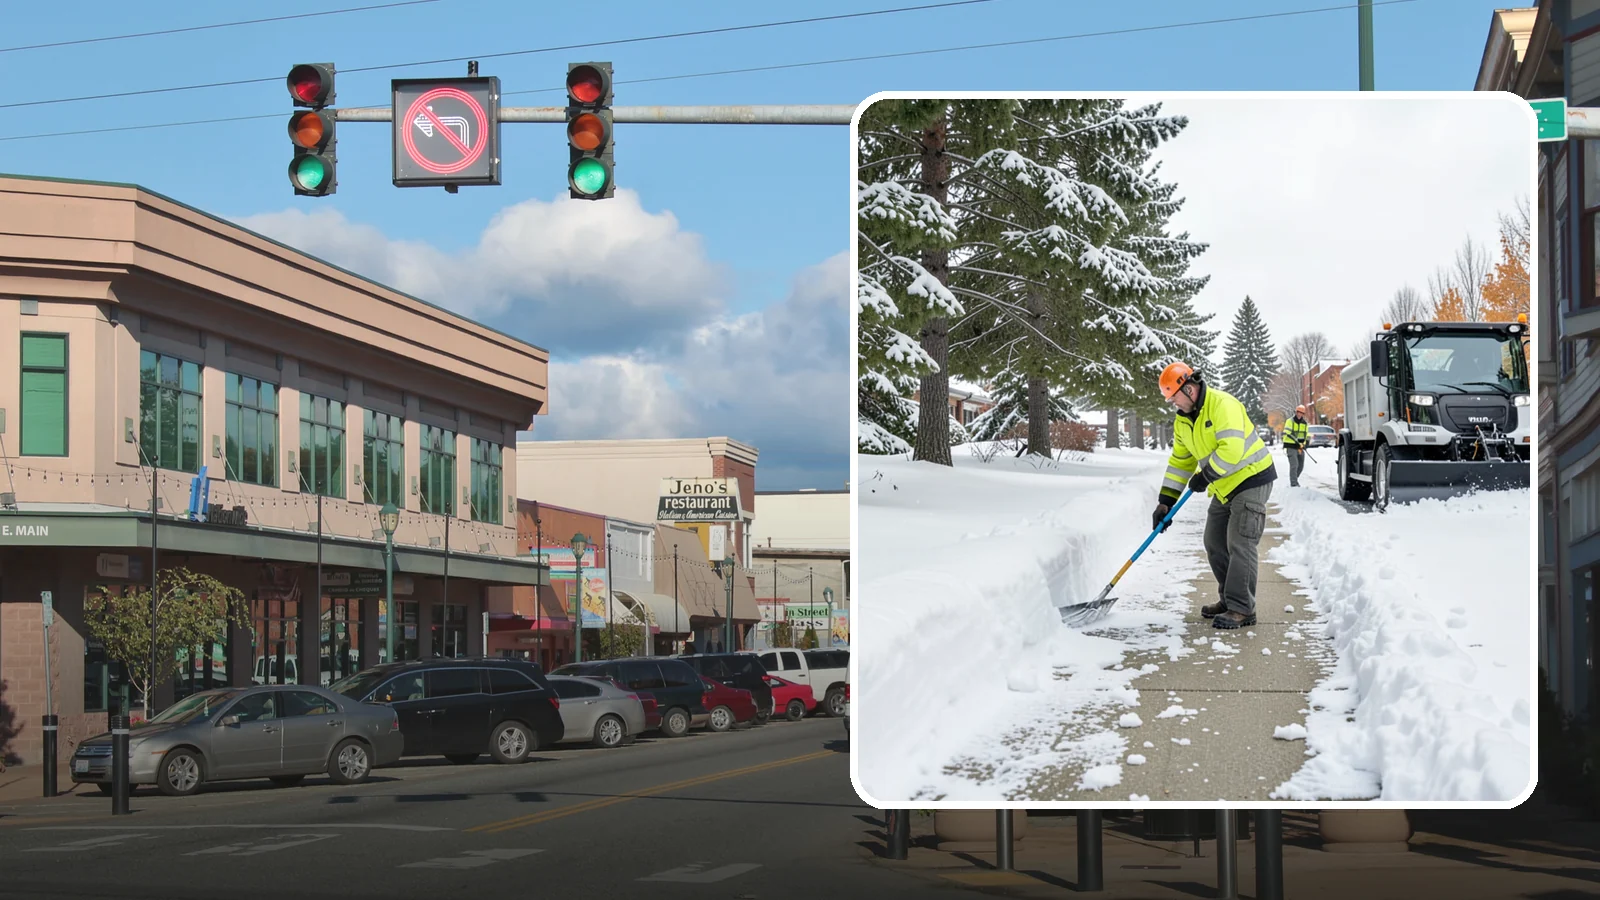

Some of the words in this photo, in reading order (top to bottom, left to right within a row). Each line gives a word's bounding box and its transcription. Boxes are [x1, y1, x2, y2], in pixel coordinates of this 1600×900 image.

[670, 480, 728, 494] Jeno's
[665, 496, 731, 509] restaurant
[659, 510, 682, 519] Italian
[686, 510, 715, 519] American
[715, 509, 737, 519] Cuisine
[2, 525, 13, 536] E.
[15, 525, 49, 536] MAIN
[797, 608, 829, 617] Street
